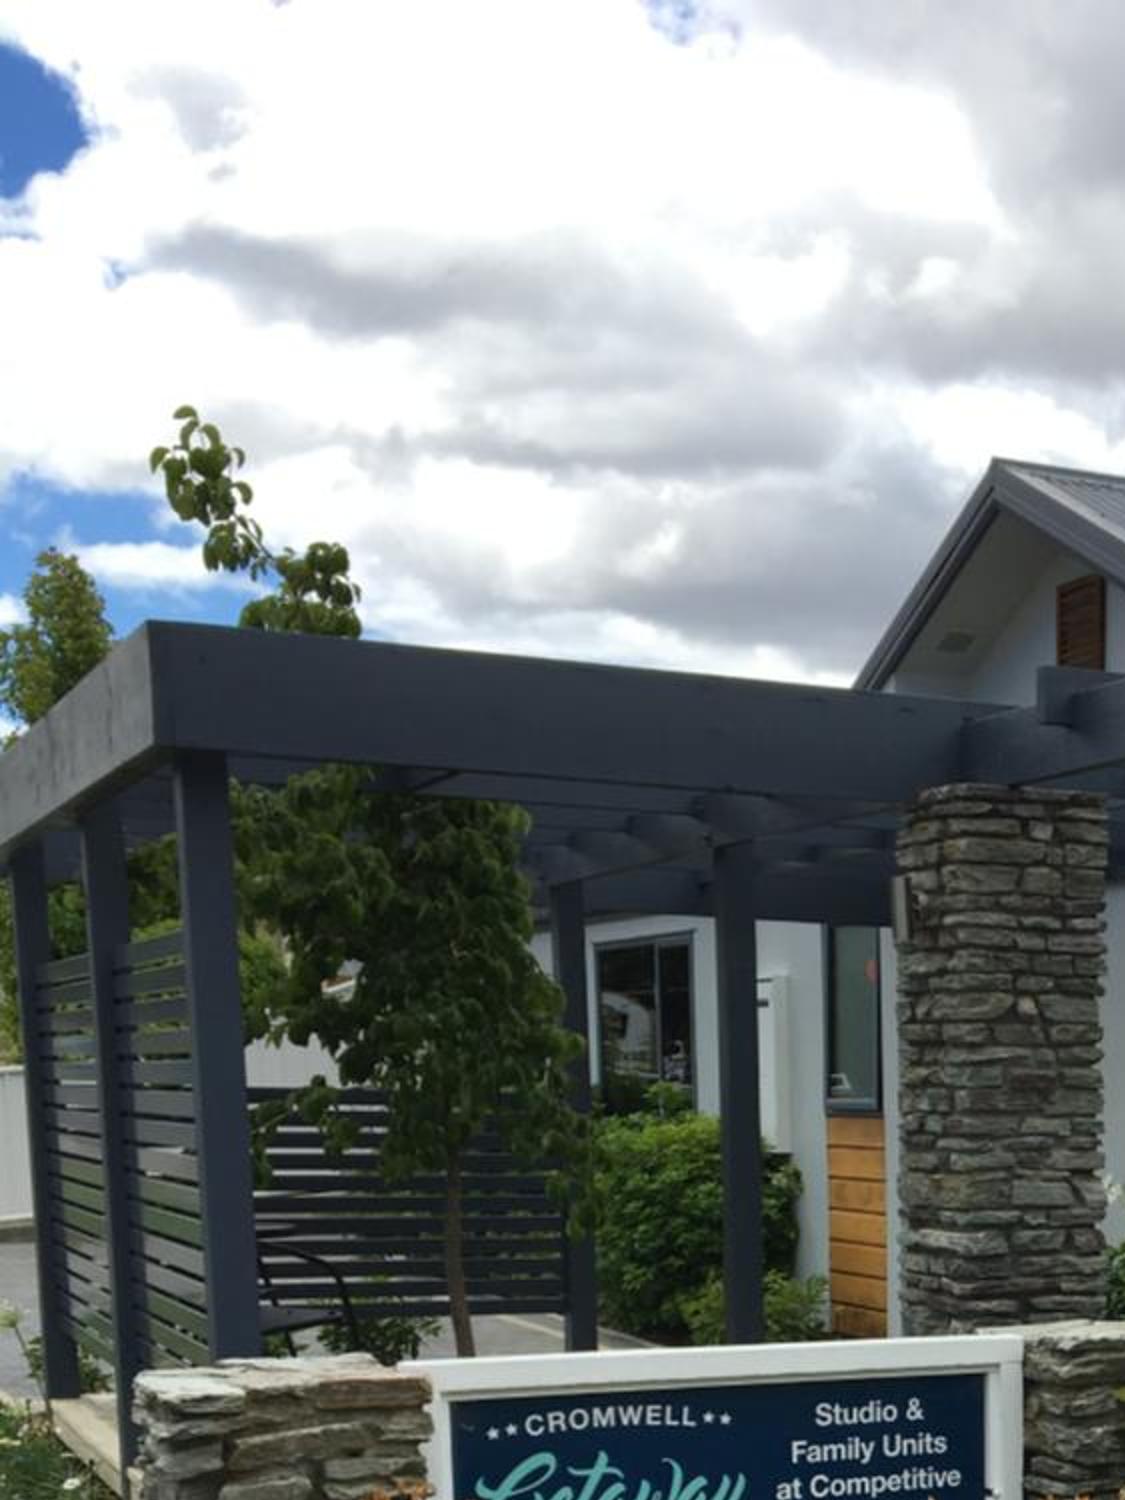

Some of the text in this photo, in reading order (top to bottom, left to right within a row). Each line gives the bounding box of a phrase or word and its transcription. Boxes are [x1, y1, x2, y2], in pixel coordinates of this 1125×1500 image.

[525, 1404, 697, 1437] CROMWELL
[815, 1397, 925, 1427] Studio &
[790, 1432, 948, 1464] Family Units
[775, 1466, 962, 1500] at Competitive
